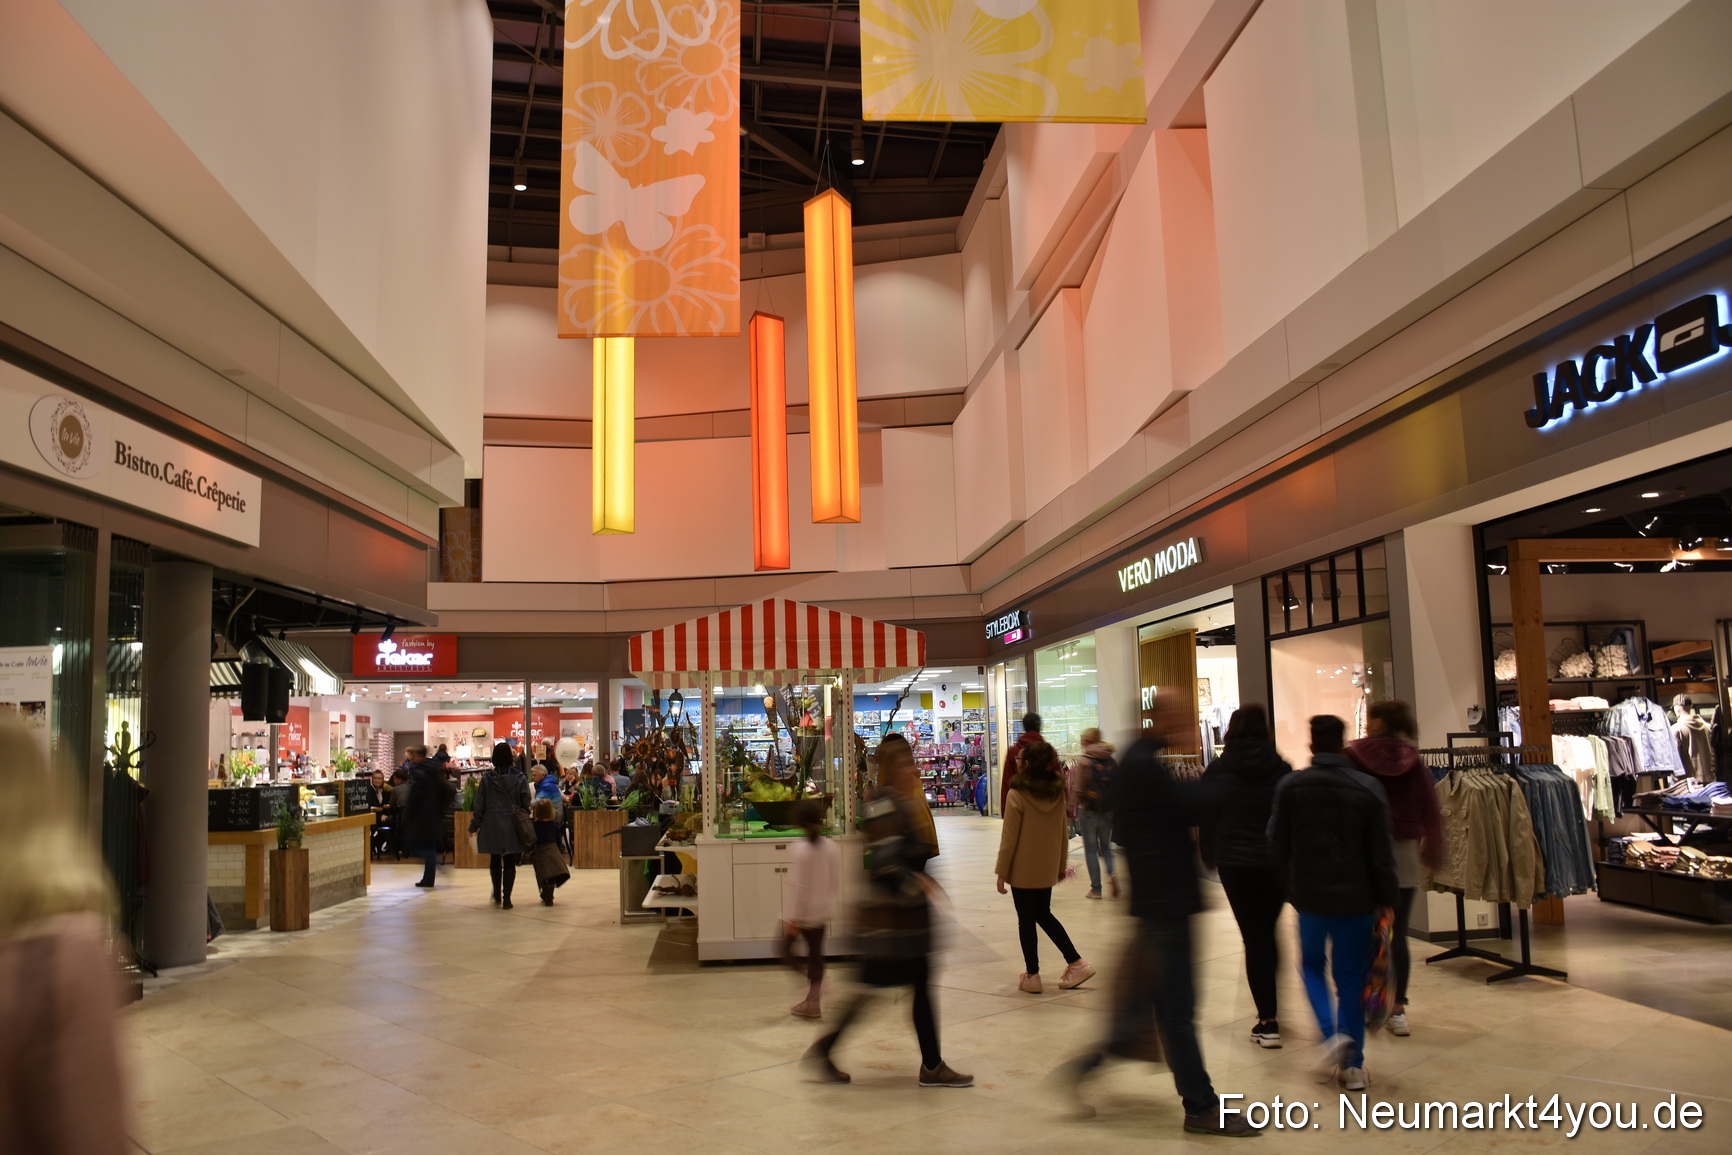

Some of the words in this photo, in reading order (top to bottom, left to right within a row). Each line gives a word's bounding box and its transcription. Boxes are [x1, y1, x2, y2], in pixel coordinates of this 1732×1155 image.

[1523, 322, 1658, 429] JACK
[115, 439, 246, 514] Bistro.Café.Crêperie
[1118, 561, 1152, 593] VERO
[1153, 536, 1198, 580] MODA
[375, 648, 434, 666] rieker
[402, 638, 425, 648] fashion
[427, 638, 435, 650] by
[510, 728, 543, 737] rieer
